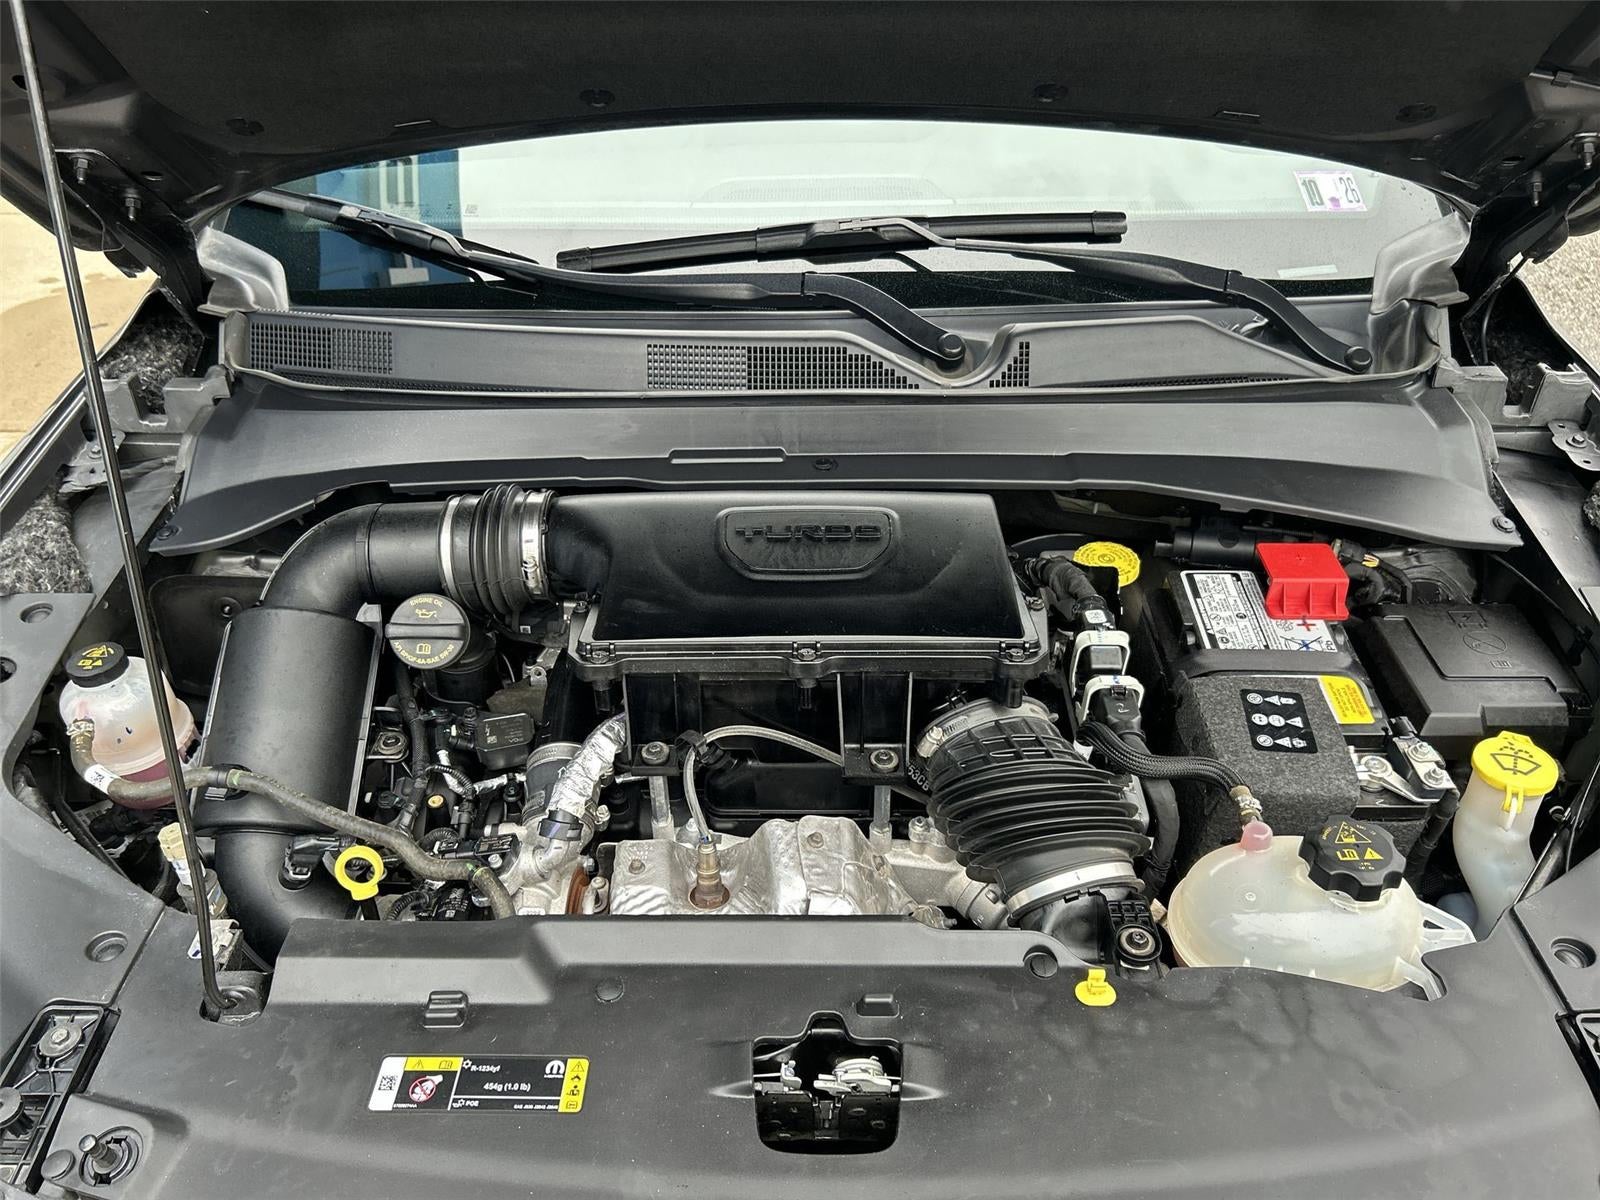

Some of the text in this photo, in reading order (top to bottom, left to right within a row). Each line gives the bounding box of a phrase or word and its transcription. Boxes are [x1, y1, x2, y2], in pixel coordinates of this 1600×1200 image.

[1301, 176, 1361, 206] 10 26
[735, 525, 882, 541] TURBO
[409, 597, 433, 606] ENGINE
[470, 1064, 501, 1073] R-1234yf
[483, 1082, 531, 1092] 454g (1.0 lb)
